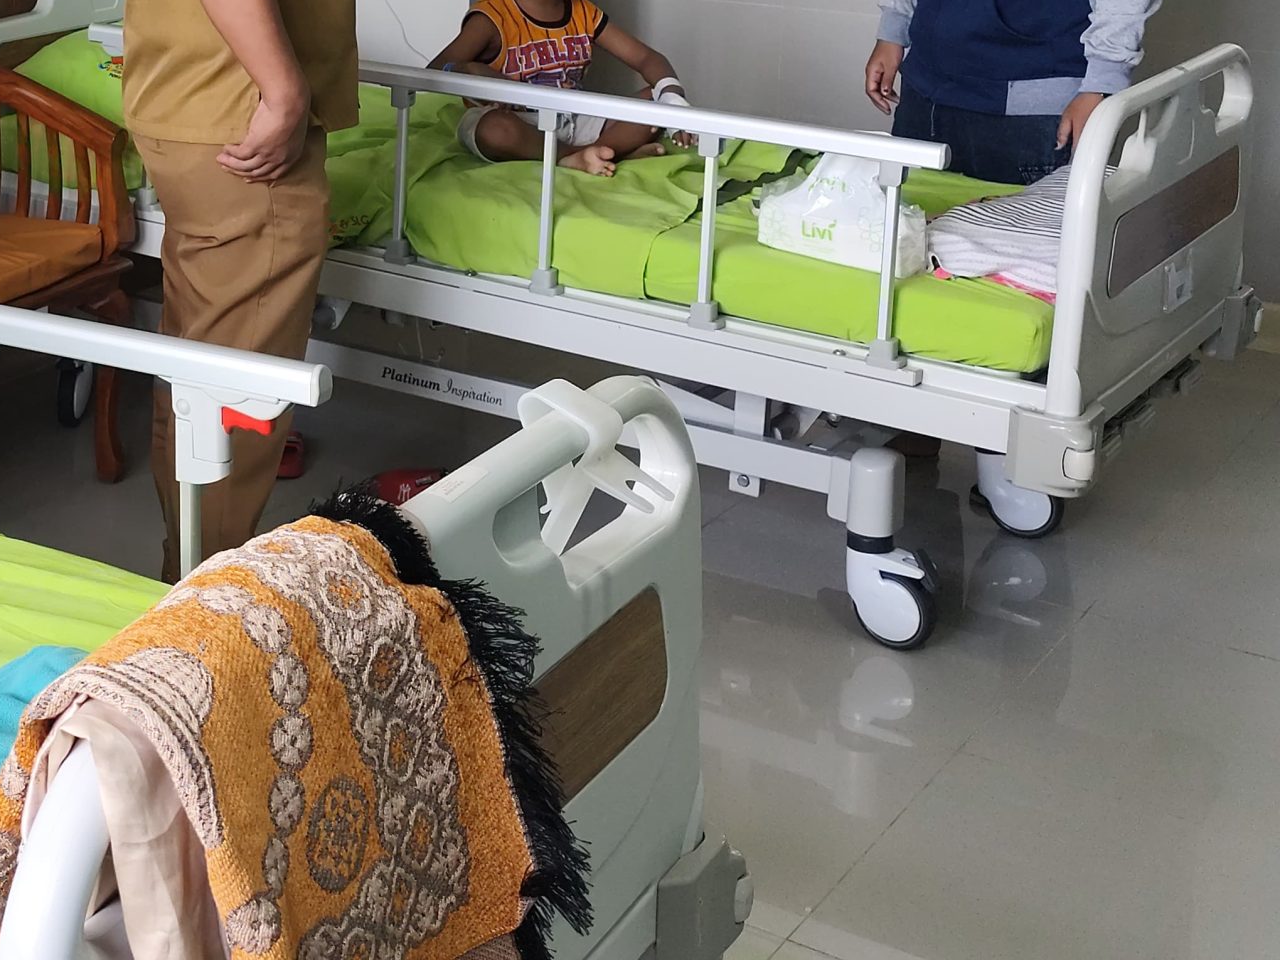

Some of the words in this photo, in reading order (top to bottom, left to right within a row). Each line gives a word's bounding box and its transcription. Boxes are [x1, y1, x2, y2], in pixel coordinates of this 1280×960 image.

[503, 34, 593, 74] ATHLET
[381, 366, 440, 392] Platinum
[442, 378, 502, 407] Inspiration
